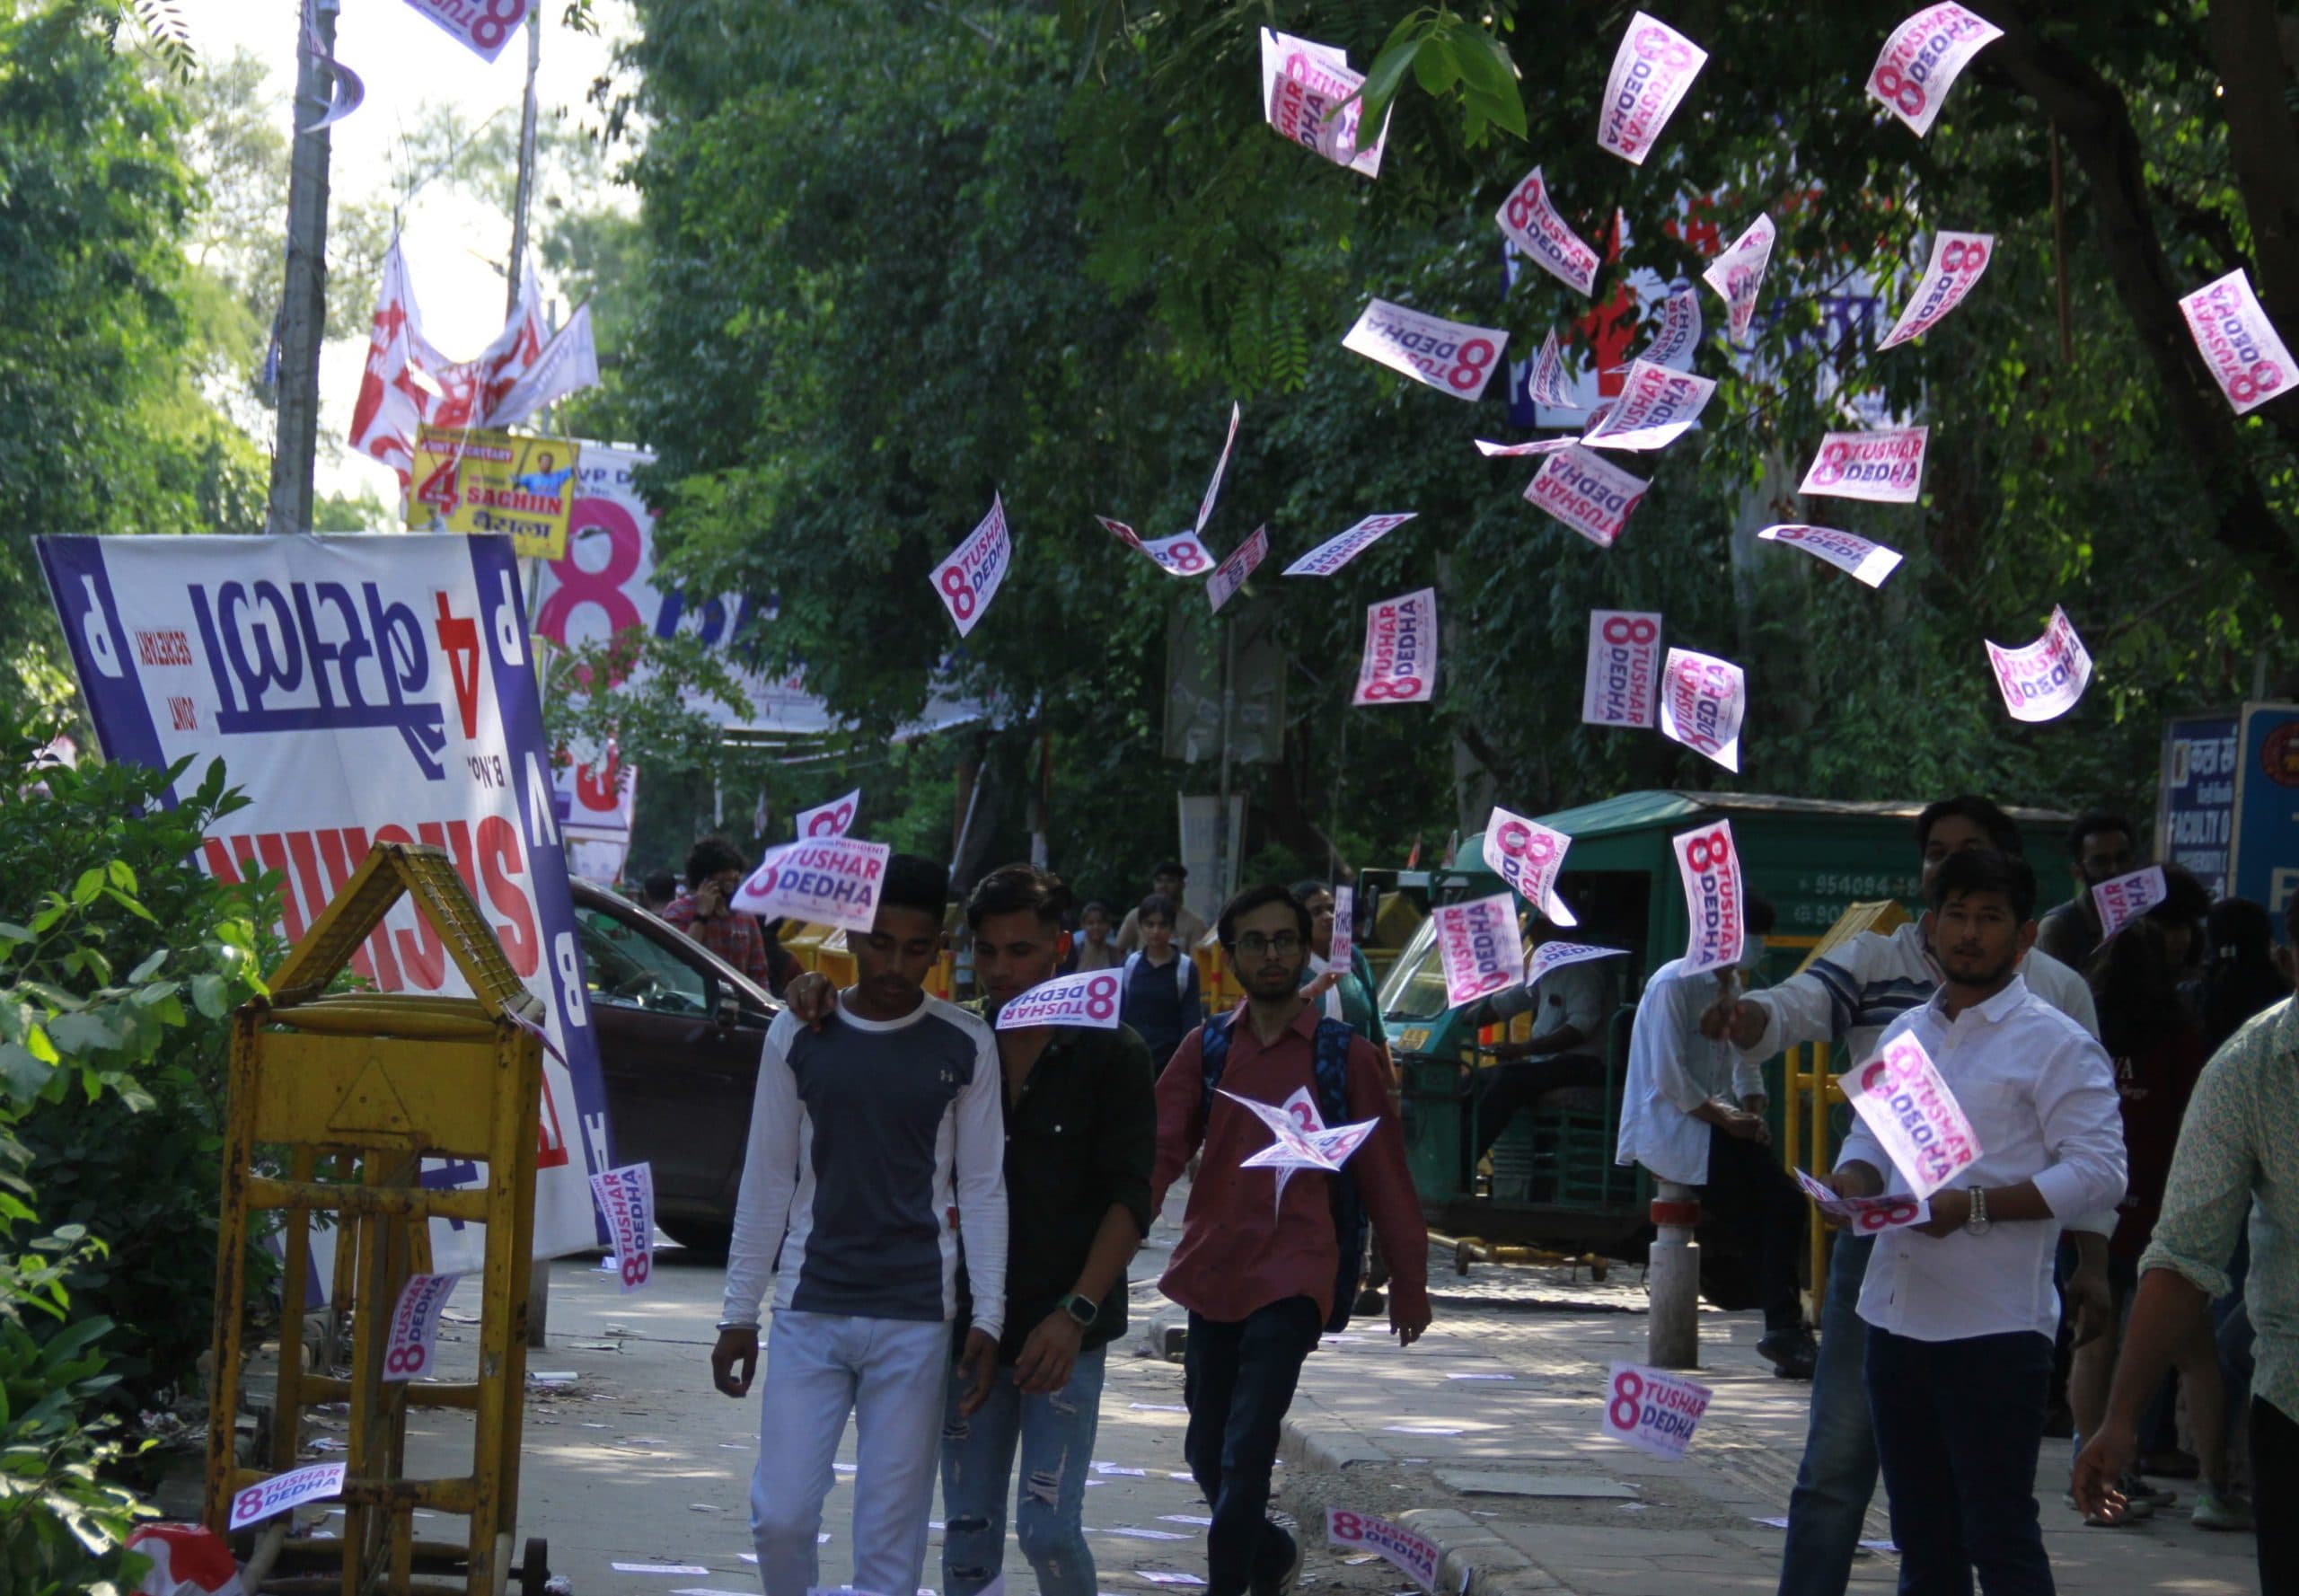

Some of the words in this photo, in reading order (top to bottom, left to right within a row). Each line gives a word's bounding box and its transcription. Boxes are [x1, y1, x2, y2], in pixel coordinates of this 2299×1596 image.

[471, 0, 524, 48] 8
[1889, 7, 1960, 68] TUSHAR
[1634, 29, 1694, 77] 8
[1909, 18, 1981, 83] DEDHA
[1607, 60, 1652, 145] DEDHA
[1619, 68, 1674, 155] TUSHAR
[1876, 65, 1925, 116] 8
[1299, 95, 1324, 151] DHA
[1507, 178, 1541, 229] 8
[1527, 221, 1589, 286] DEDHA
[1535, 203, 1595, 269] TUSHAR
[1942, 240, 1986, 273] 8
[1364, 317, 1457, 357] DEDHA
[2190, 296, 2240, 377] TUSHAR
[2211, 285, 2259, 362] DEDHA
[1448, 339, 1495, 391] 8
[2228, 360, 2283, 402] 8
[1612, 367, 1667, 431] TUSHAR
[1812, 440, 1850, 487] 8
[1845, 463, 1916, 483] DEDHA
[1850, 436, 1923, 462] TUSHAR
[418, 460, 460, 516] 4
[467, 486, 563, 516] SACHIIN
[1535, 475, 1617, 533] TUSHAR
[1548, 456, 1626, 514] DEDHA
[1361, 516, 1406, 531] 8
[1168, 542, 1205, 570] 8
[1317, 529, 1374, 573] TUSHAR
[539, 498, 642, 693] 8
[941, 566, 975, 620] 8
[135, 630, 193, 666] SECRETARY
[1371, 605, 1396, 679] TUSHAR
[1395, 599, 1416, 676] DEDHA
[1602, 616, 1657, 646] 8
[188, 579, 447, 781] बैसला
[436, 591, 480, 740] 4
[1363, 676, 1423, 700] 8
[1606, 648, 1630, 722] DEDHA
[1629, 646, 1652, 726] TUSHAR
[1675, 658, 1701, 722] TUSHAR
[2021, 636, 2081, 699] DEDHA
[167, 697, 198, 732] JOINT
[1696, 665, 1725, 738] DEDHA
[1678, 719, 1722, 754] 8
[809, 803, 852, 837] 8
[1497, 821, 1555, 867] 8
[785, 850, 883, 881] TUSHAR
[1687, 831, 1728, 874] 8
[777, 869, 874, 906] DEDHA
[1467, 903, 1498, 974] DEDHA
[1700, 875, 1719, 966] DEDHA
[1715, 867, 1734, 962] TUSHAR
[1444, 908, 1475, 984] TUSHAR
[1001, 1001, 1084, 1021] TUSHAR
[1011, 985, 1085, 1006] DEDHA
[1086, 975, 1118, 1020] 8
[1453, 971, 1509, 1001] 8
[1891, 1094, 1951, 1182] DEDHA
[1911, 1074, 1972, 1168] TUSHAR
[603, 1173, 635, 1257] TUSHAR
[622, 1169, 646, 1251] DEDHA
[1861, 1201, 1920, 1230] 8
[622, 1252, 647, 1287] 8
[395, 1276, 428, 1345] TUSHAR
[409, 1275, 446, 1342] DEDHA
[387, 1343, 426, 1374] 8
[1610, 1371, 1644, 1431] 8
[1641, 1405, 1696, 1440] DEDHA
[1645, 1382, 1705, 1421] TUSHAR
[235, 1487, 263, 1521] 8
[264, 1476, 338, 1507] DEDHA
[266, 1467, 340, 1499] TUSHAR
[1333, 1512, 1363, 1542] 8
[1364, 1521, 1437, 1563] TUSHAR
[1365, 1530, 1434, 1578] DEDHA
